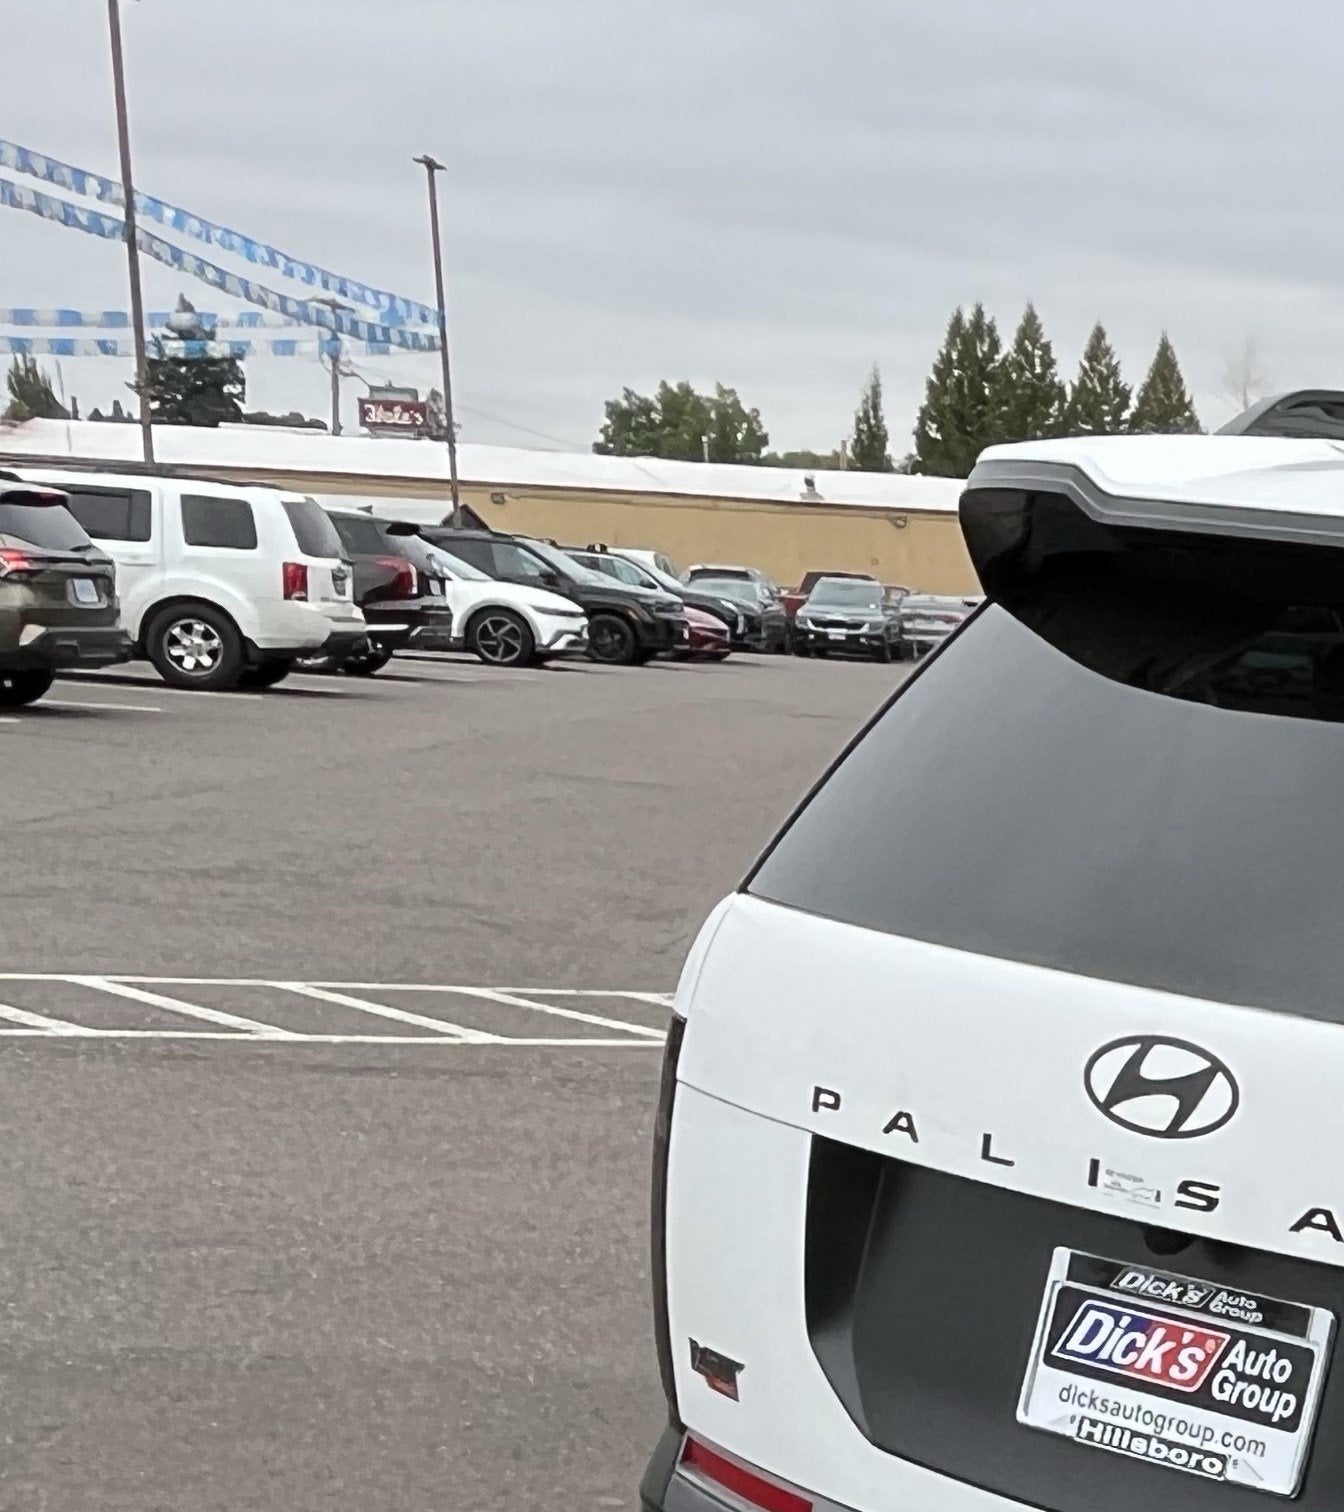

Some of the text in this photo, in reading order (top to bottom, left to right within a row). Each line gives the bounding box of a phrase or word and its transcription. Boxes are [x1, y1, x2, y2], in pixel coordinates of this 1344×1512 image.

[1118, 1271, 1205, 1304] Dick's
[1209, 1299, 1263, 1324] Group
[1215, 1291, 1258, 1310] Auto
[1065, 1309, 1206, 1381] Dick's
[1222, 1339, 1293, 1384] Auto
[1058, 1383, 1267, 1458] dicksautogroup.com
[1211, 1369, 1297, 1423] Group
[1078, 1416, 1223, 1476] Hillsboro
